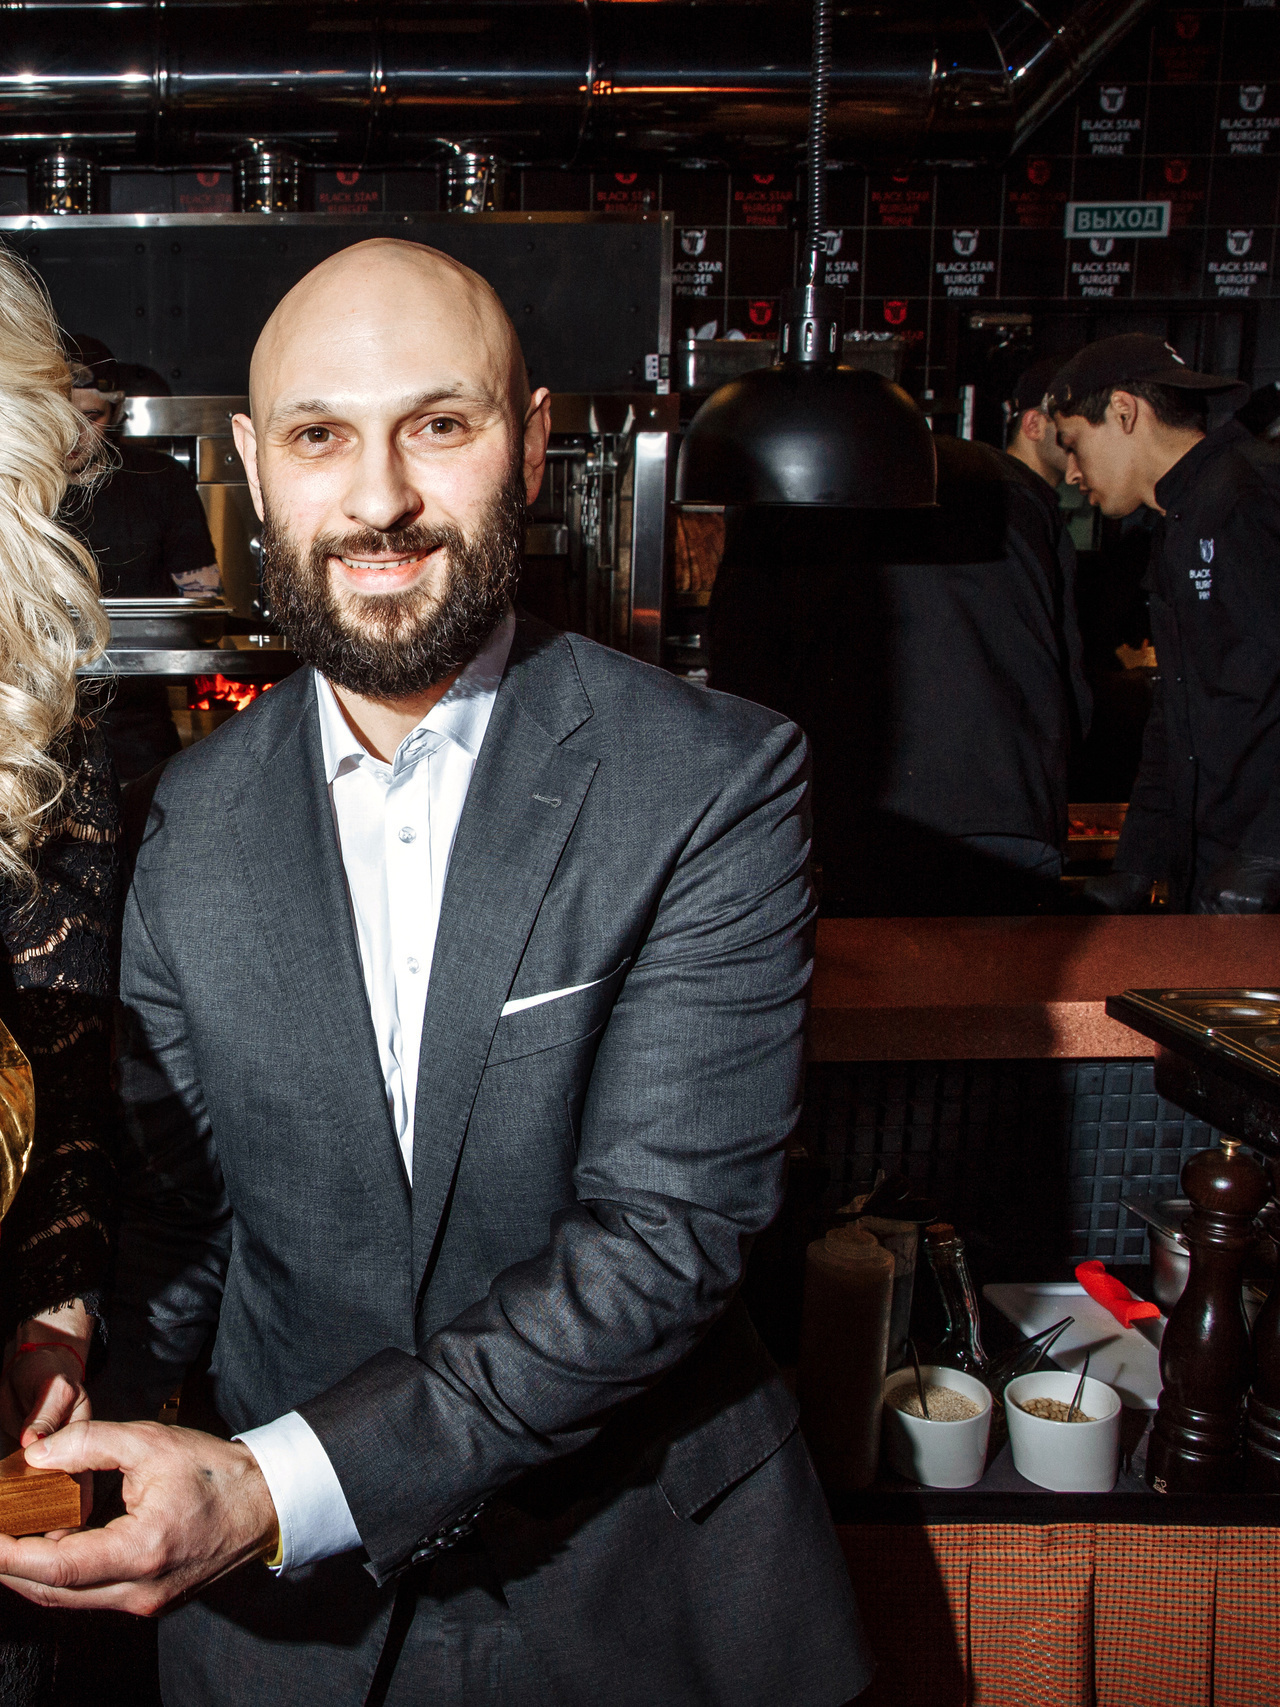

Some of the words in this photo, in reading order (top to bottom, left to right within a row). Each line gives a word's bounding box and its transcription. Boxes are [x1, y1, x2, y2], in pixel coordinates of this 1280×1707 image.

[1081, 119, 1114, 130] BLACK
[1116, 118, 1141, 130] STAR
[1220, 118, 1253, 129] BLACK
[1088, 131, 1131, 142] BURGER
[1227, 130, 1270, 142] BURGER
[1076, 208, 1160, 230] ВЫХОД
[675, 261, 696, 272] ACK
[698, 261, 723, 272] STAR
[834, 261, 859, 272] STAR
[936, 262, 968, 273] BLACK
[970, 261, 995, 272] STAR
[1072, 262, 1103, 273] BLACK
[1106, 262, 1130, 273] STAR
[1208, 262, 1240, 273] BLACK
[1242, 261, 1268, 273] STAR
[943, 274, 985, 285] BURGER
[1078, 274, 1120, 285] BURGER
[1215, 274, 1257, 285] BURGER
[676, 286, 708, 296] PRIME
[947, 286, 979, 297] PRIME
[1082, 286, 1114, 297] PRIME
[1218, 286, 1250, 297] PRIME
[1189, 568, 1212, 579] BLACK
